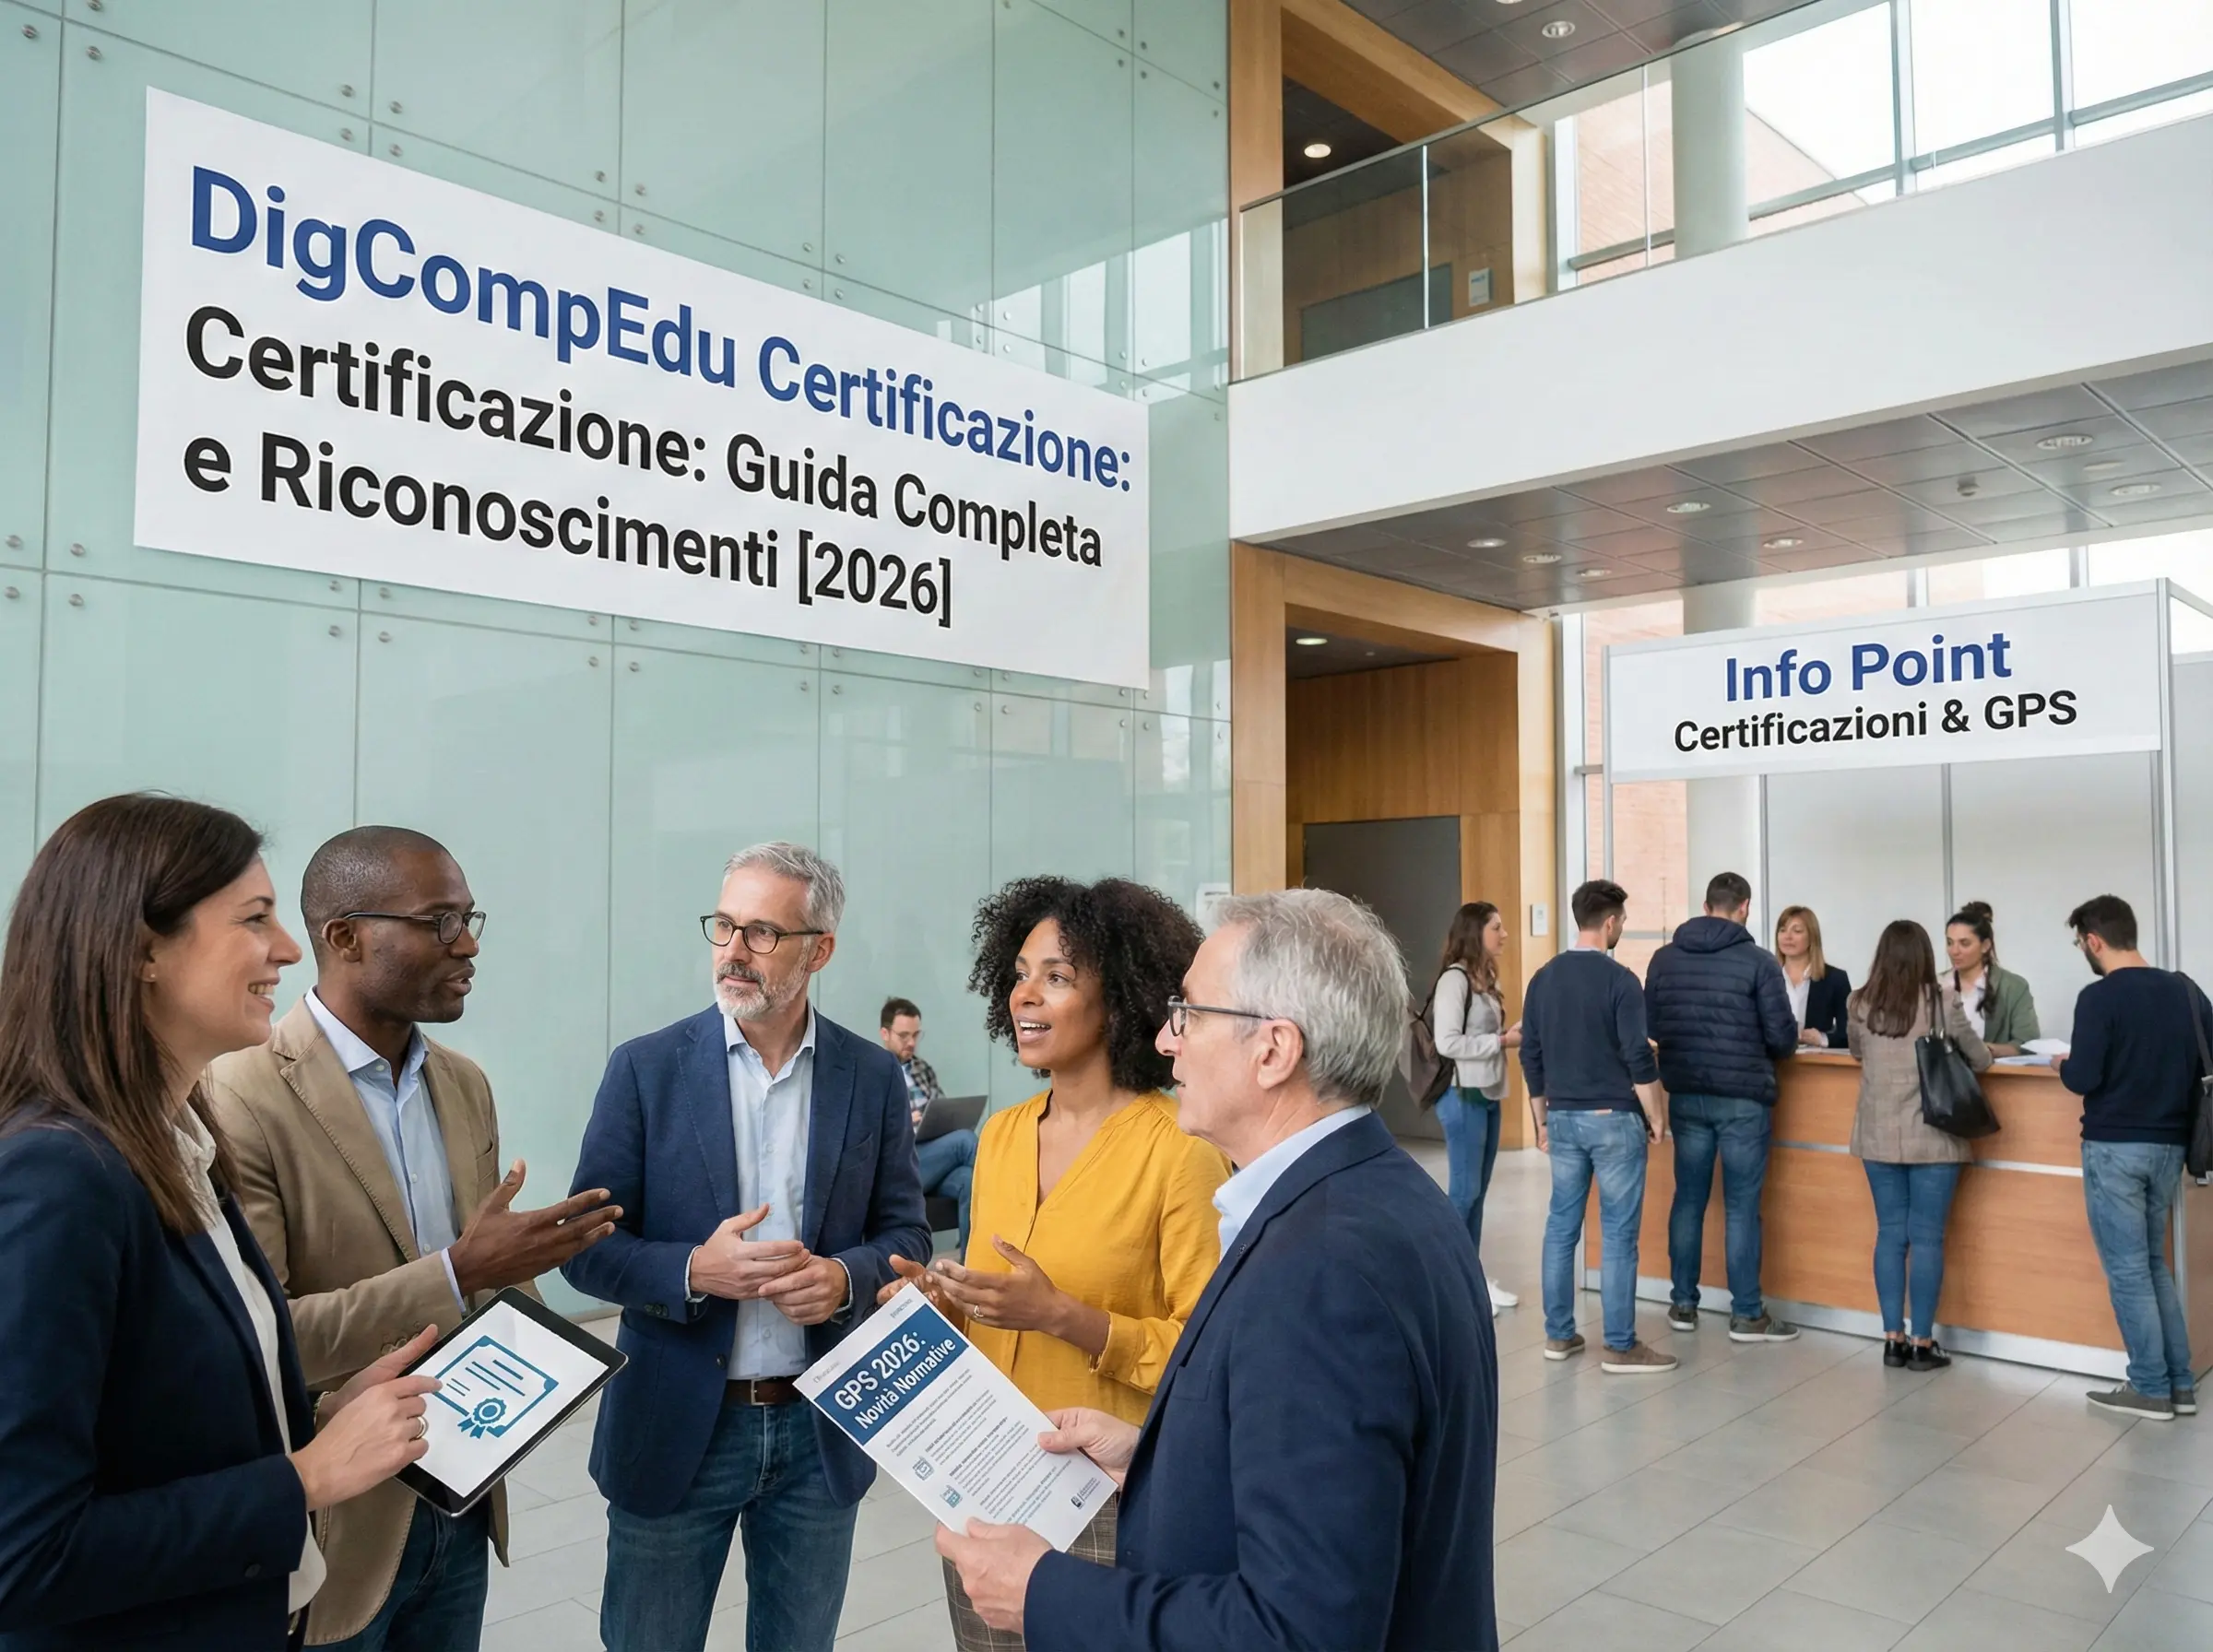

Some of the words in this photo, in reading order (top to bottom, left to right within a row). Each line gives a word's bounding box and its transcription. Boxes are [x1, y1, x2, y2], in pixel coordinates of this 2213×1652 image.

[187, 164, 737, 389] DigCompEdu
[758, 336, 1131, 492] Certificazione:
[186, 305, 706, 483] Certificazione:
[726, 433, 879, 520] Guida
[893, 473, 1102, 568] Completa
[183, 437, 231, 493] e
[260, 431, 778, 588] Riconoscimenti
[799, 528, 952, 629] [2026]
[1726, 648, 1832, 702] Info
[1852, 632, 2012, 691] Point
[1675, 701, 1927, 752] Certificazioni
[1941, 699, 1971, 734] &
[1984, 690, 2077, 730] GPS
[834, 1370, 879, 1410] GPS
[871, 1331, 927, 1380] 2026:
[854, 1387, 900, 1430] Novità
[892, 1339, 956, 1395] Normative
